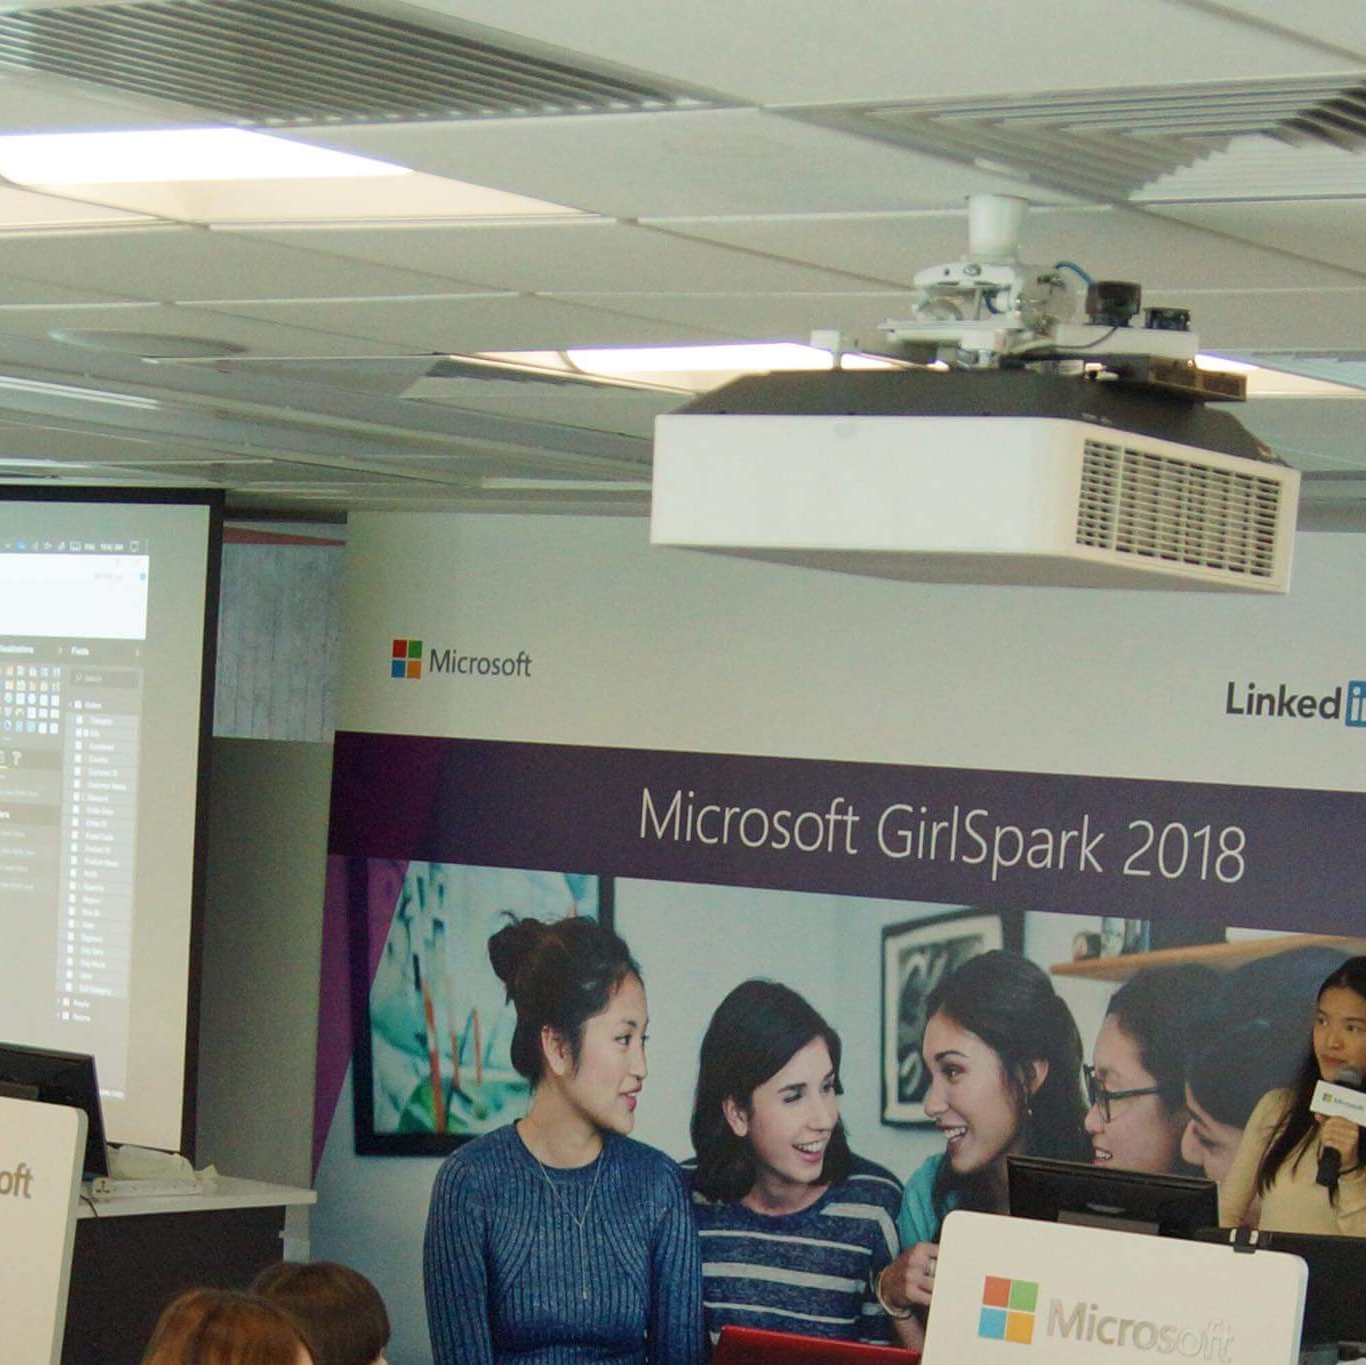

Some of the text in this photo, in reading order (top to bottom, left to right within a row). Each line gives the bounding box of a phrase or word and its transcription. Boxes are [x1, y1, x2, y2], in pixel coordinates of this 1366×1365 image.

[430, 648, 533, 678] Microsoft
[640, 786, 1247, 884] Microsoft GirlSpark 2018
